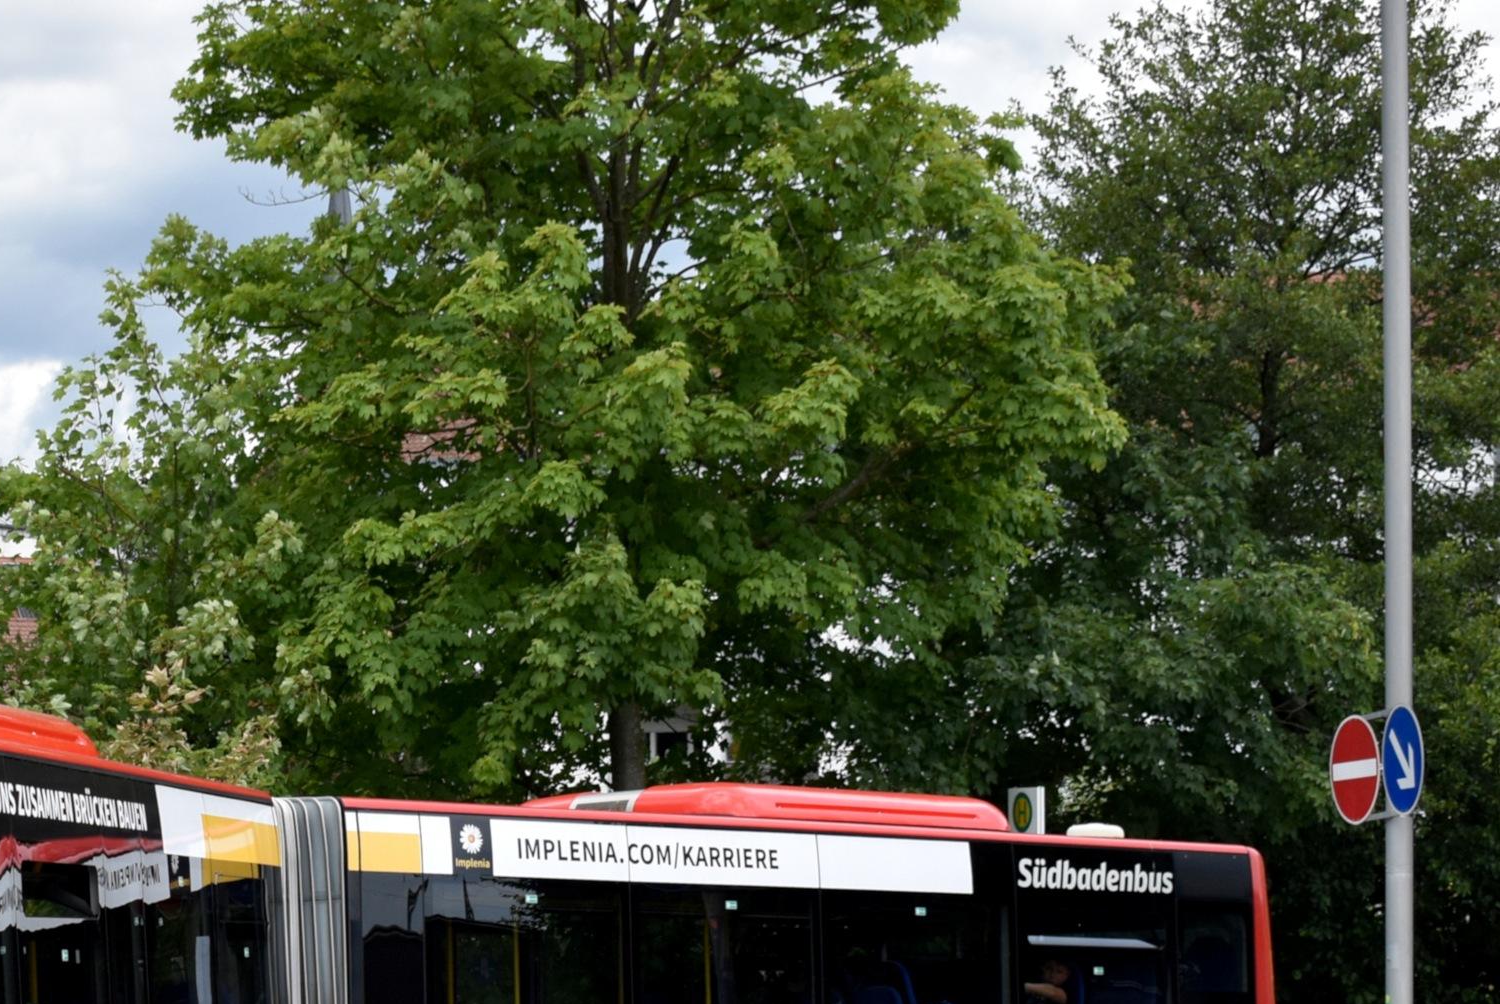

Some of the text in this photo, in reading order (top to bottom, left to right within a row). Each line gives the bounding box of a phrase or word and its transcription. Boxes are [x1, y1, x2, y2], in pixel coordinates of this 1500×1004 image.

[15, 784, 74, 822] ZUSAMMEN
[73, 788, 118, 828] BRÜCKEN
[117, 800, 148, 831] BAUEN
[1015, 799, 1029, 827] H
[455, 857, 490, 870] Implenia
[516, 837, 780, 870] IMPLENIA.COM/KARRIERE
[1017, 857, 1174, 894] Südbadenbus
